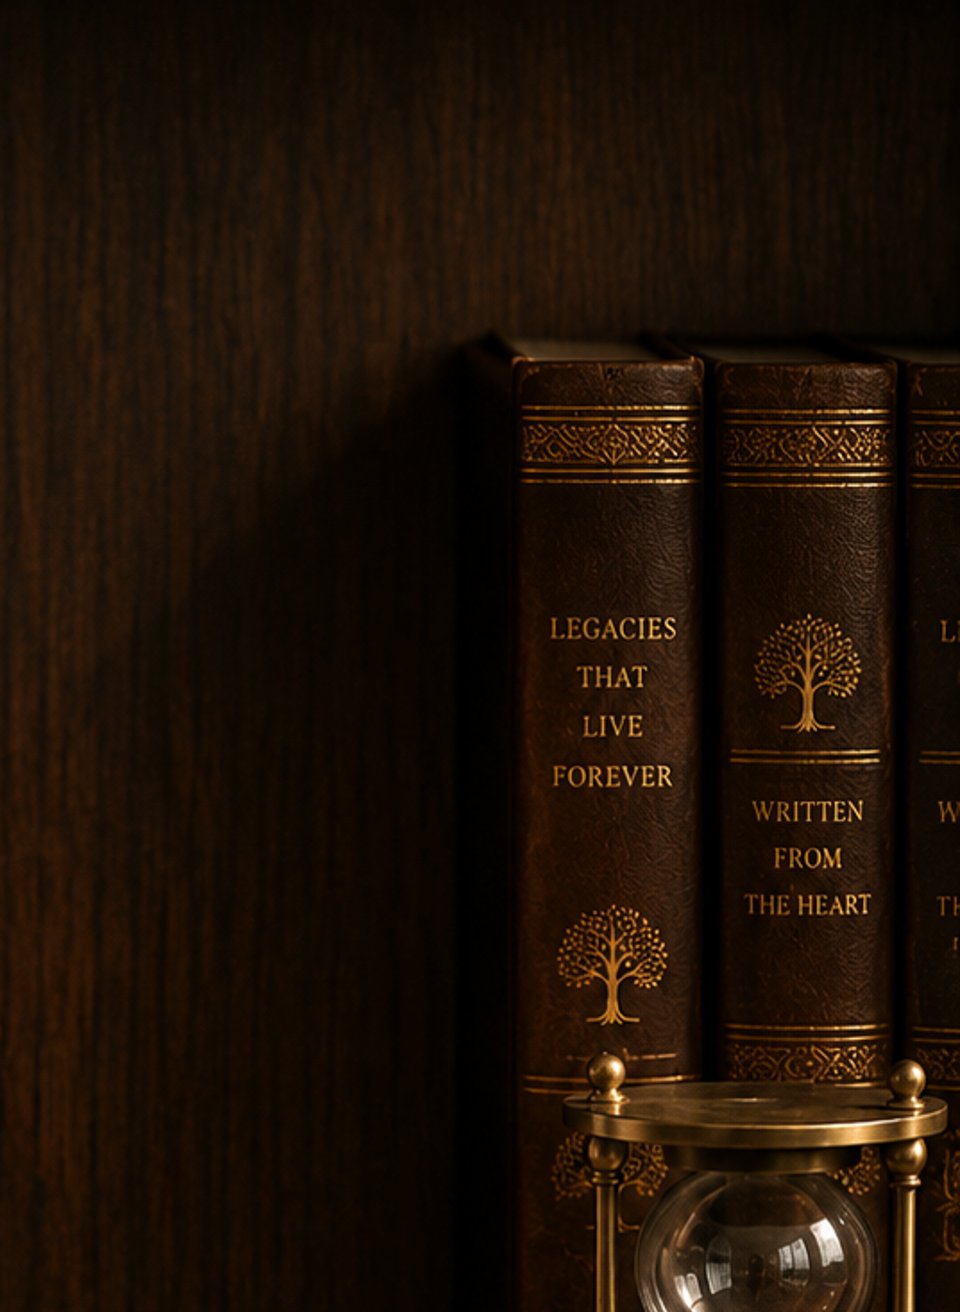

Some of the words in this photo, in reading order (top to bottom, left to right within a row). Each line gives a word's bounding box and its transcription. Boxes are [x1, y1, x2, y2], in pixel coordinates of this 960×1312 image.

[550, 616, 677, 641] LEGACIES
[939, 619, 960, 643] L
[577, 665, 648, 689] THAT
[583, 715, 643, 738] LIVE
[553, 765, 673, 788] FOREVER
[752, 799, 864, 823] WRITTEN
[774, 847, 843, 870] FROM
[744, 893, 791, 916] THE
[798, 893, 872, 916] HEART
